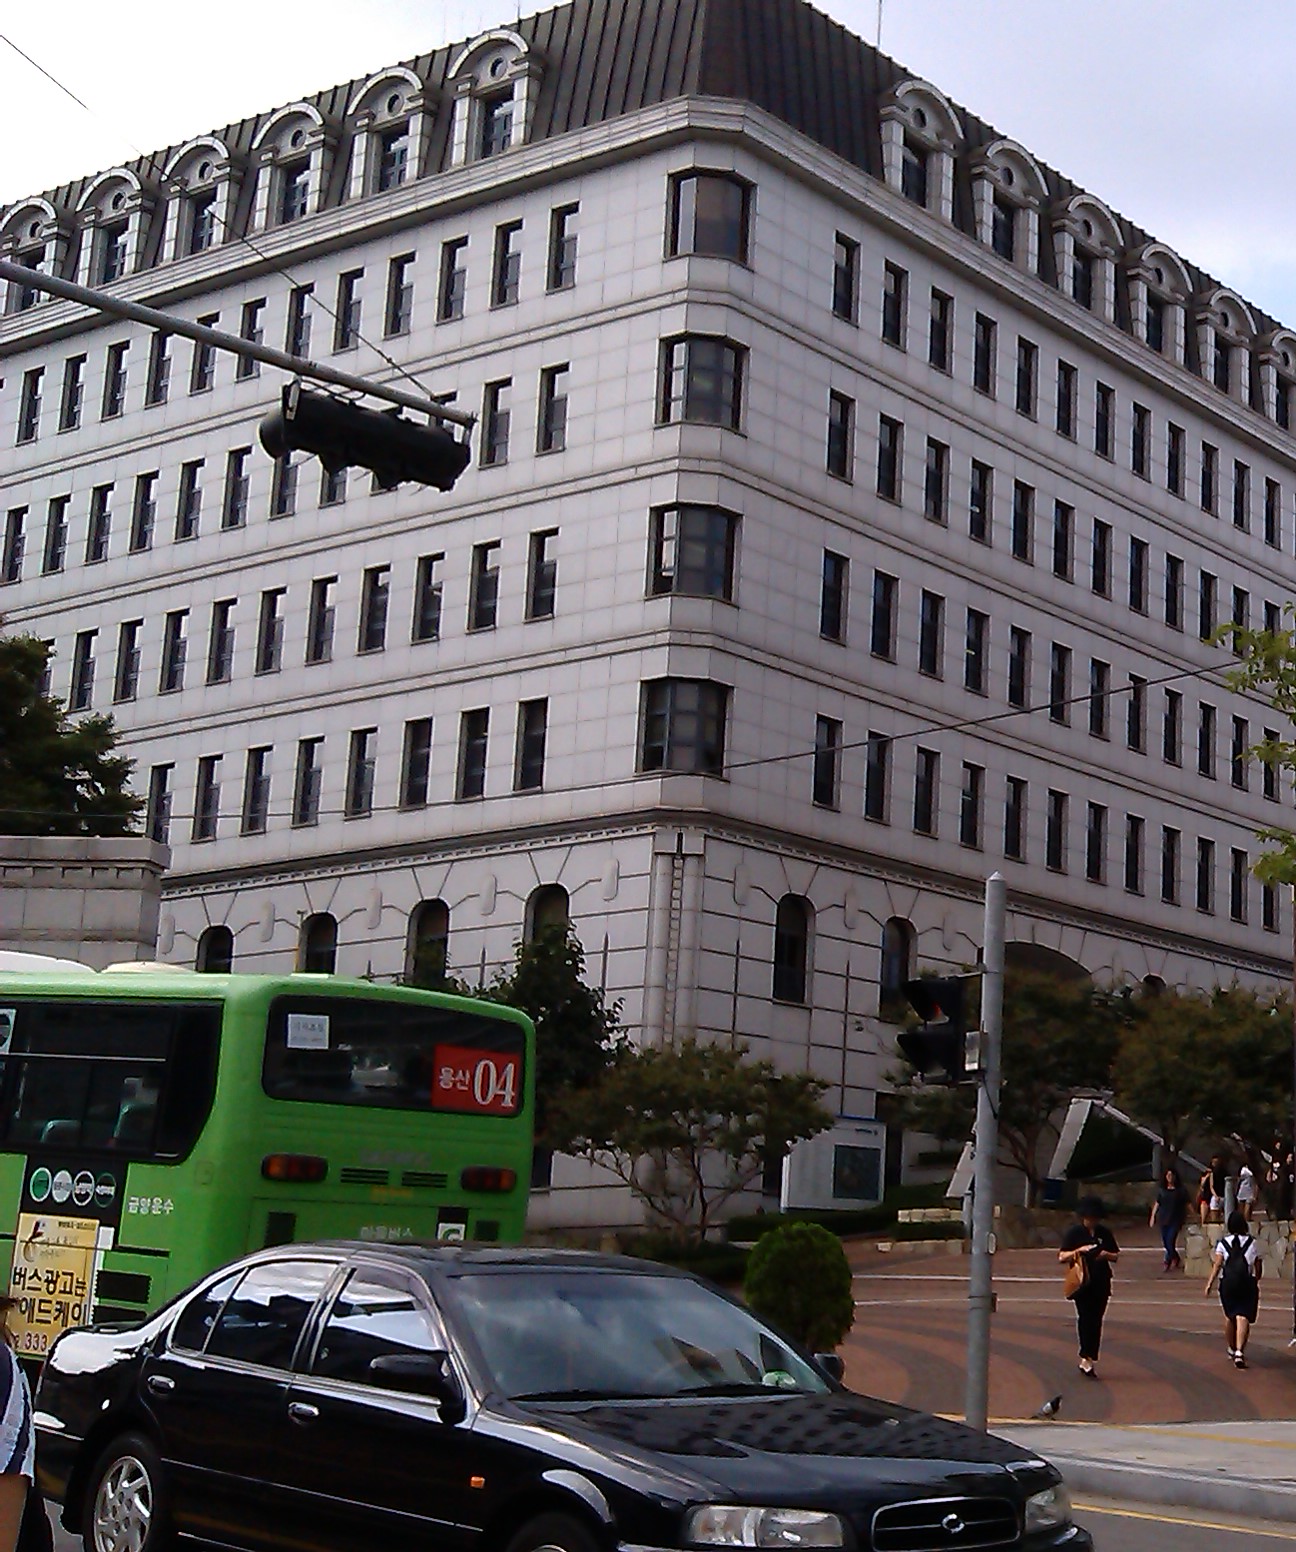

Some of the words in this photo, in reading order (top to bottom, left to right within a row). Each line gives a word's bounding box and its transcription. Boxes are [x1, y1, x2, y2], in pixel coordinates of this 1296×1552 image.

[438, 1066, 470, 1090] 용산
[473, 1058, 515, 1108] 04
[12, 1266, 87, 1298] 버스광고는
[19, 1297, 88, 1327] 애드케이
